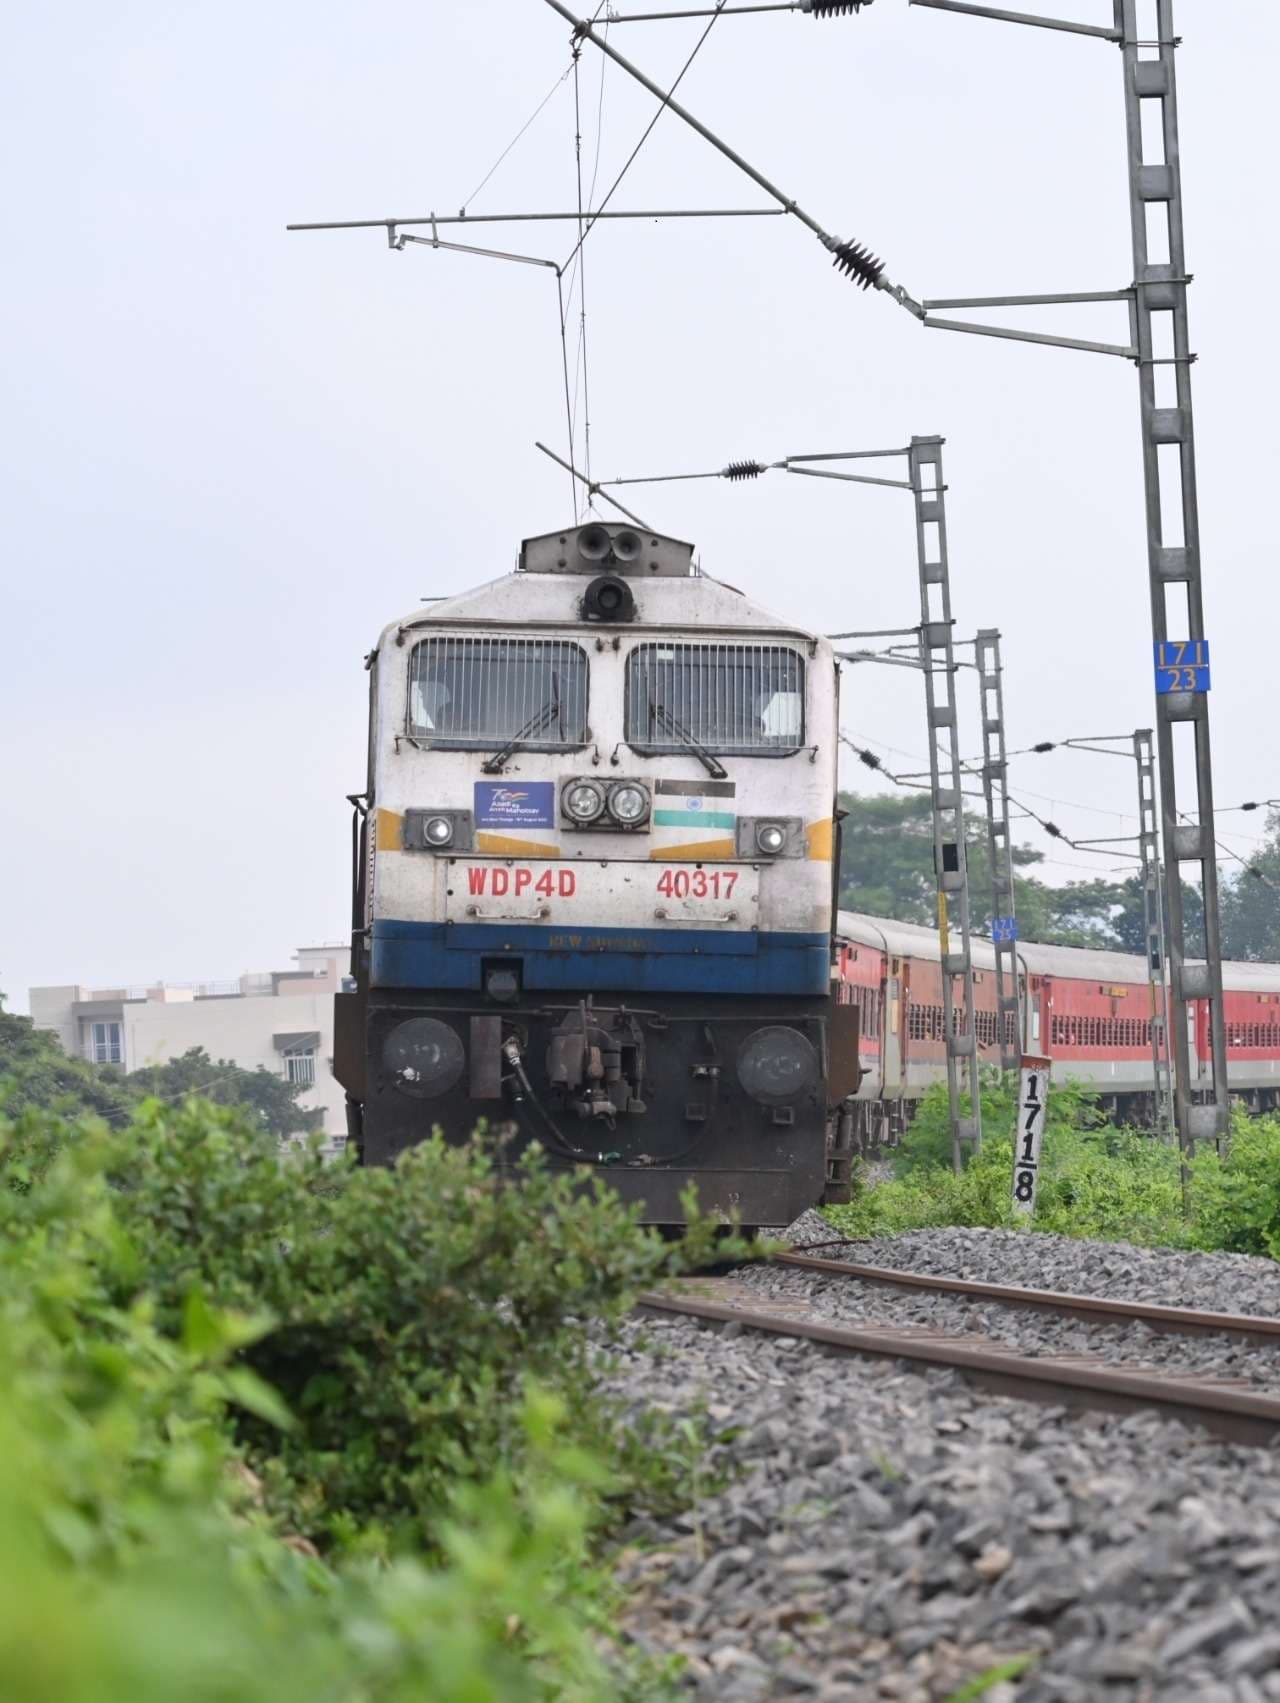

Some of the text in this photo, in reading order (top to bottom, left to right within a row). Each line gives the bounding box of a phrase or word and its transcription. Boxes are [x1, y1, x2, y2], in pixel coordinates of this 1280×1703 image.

[1159, 643, 1202, 667] 171
[1168, 668, 1196, 691] 23
[468, 868, 739, 900] WDP4D 40317
